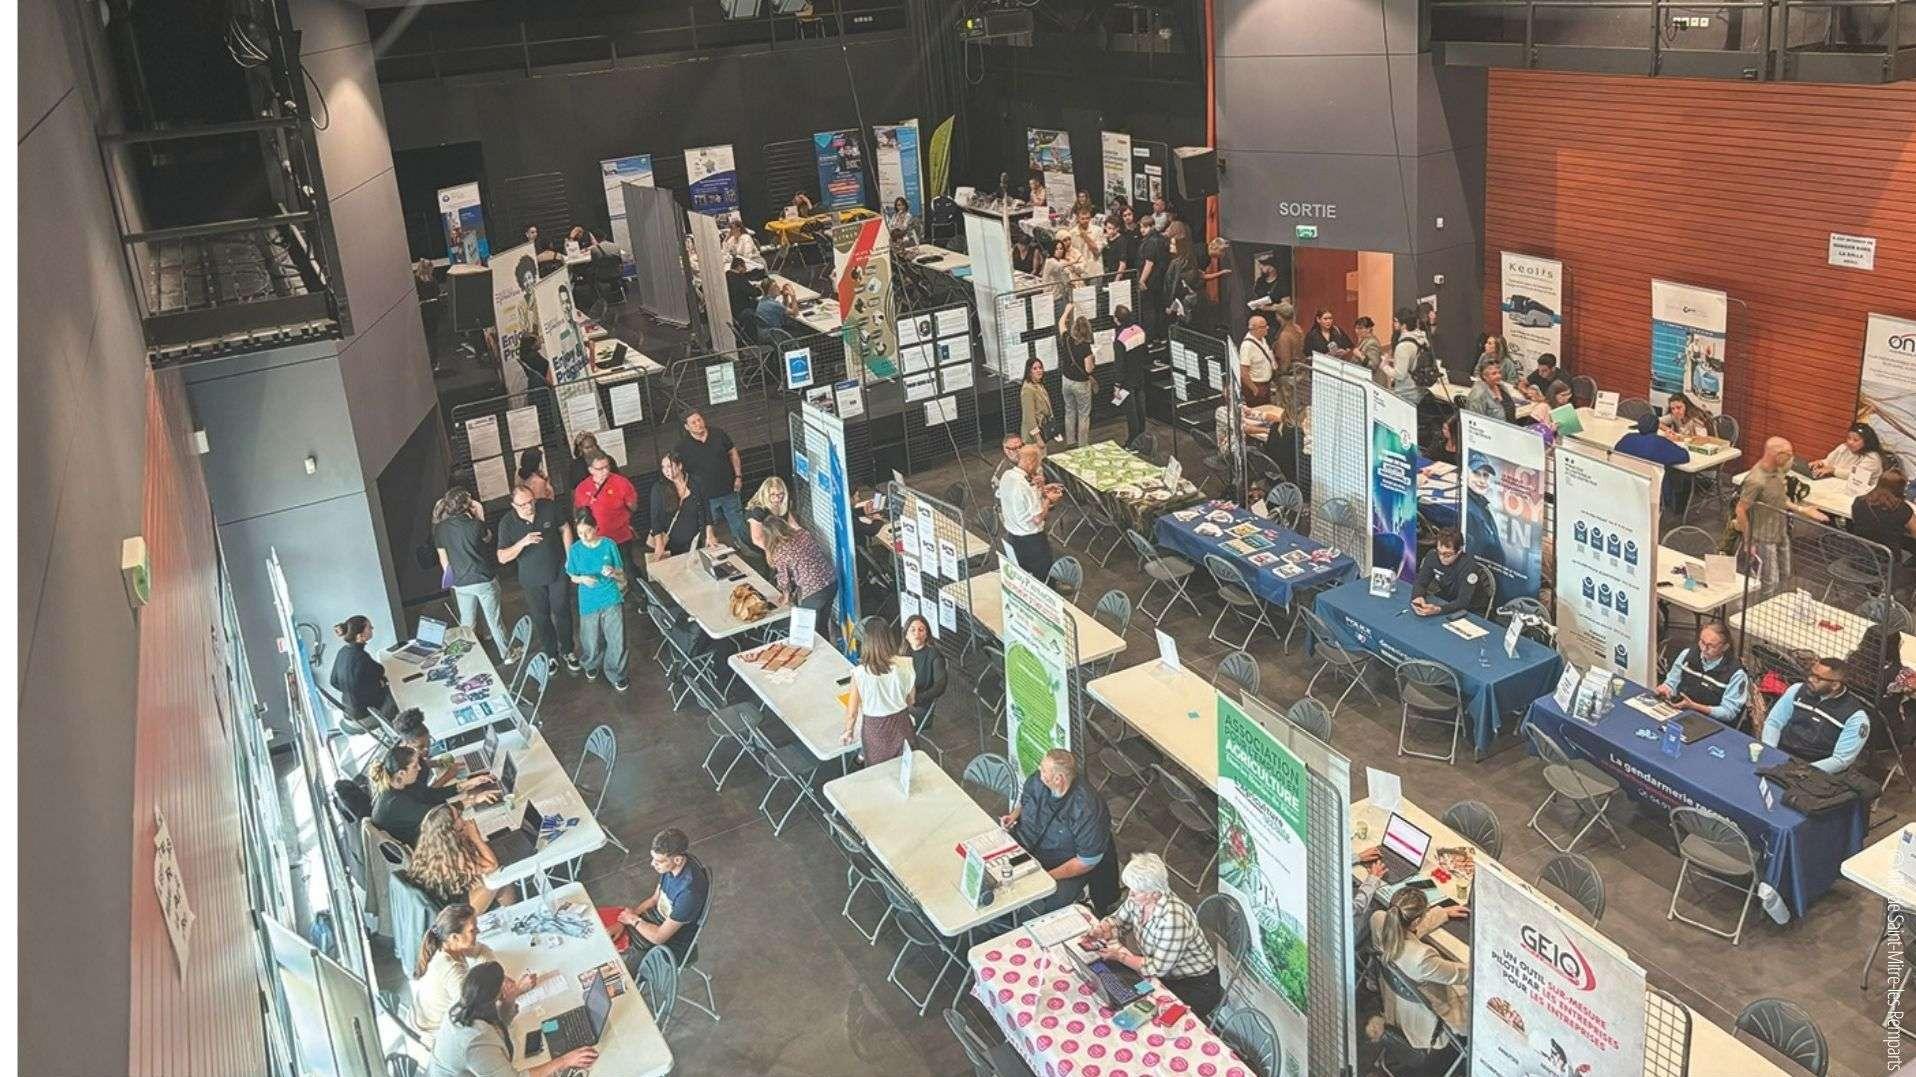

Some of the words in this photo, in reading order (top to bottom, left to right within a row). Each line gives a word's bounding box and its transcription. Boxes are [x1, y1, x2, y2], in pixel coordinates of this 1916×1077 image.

[1279, 202, 1337, 218] SORTIE
[1225, 715, 1299, 785] ASSOCIATION
[1225, 740, 1299, 810] AGRICULTURE
[1610, 753, 1622, 767] La
[1623, 763, 1694, 806] gendarmerie
[1502, 949, 1518, 964] UN
[1518, 961, 1545, 985] OUTIL
[1547, 981, 1607, 1029] SUR-MESURE
[1502, 970, 1528, 995] POUR
[1529, 991, 1545, 1008] LES
[1547, 1004, 1606, 1051] ENTREPRISES
[1521, 973, 1540, 992] PAR
[1542, 987, 1558, 1006] LES
[1558, 1000, 1619, 1050] ENTREPRISES
